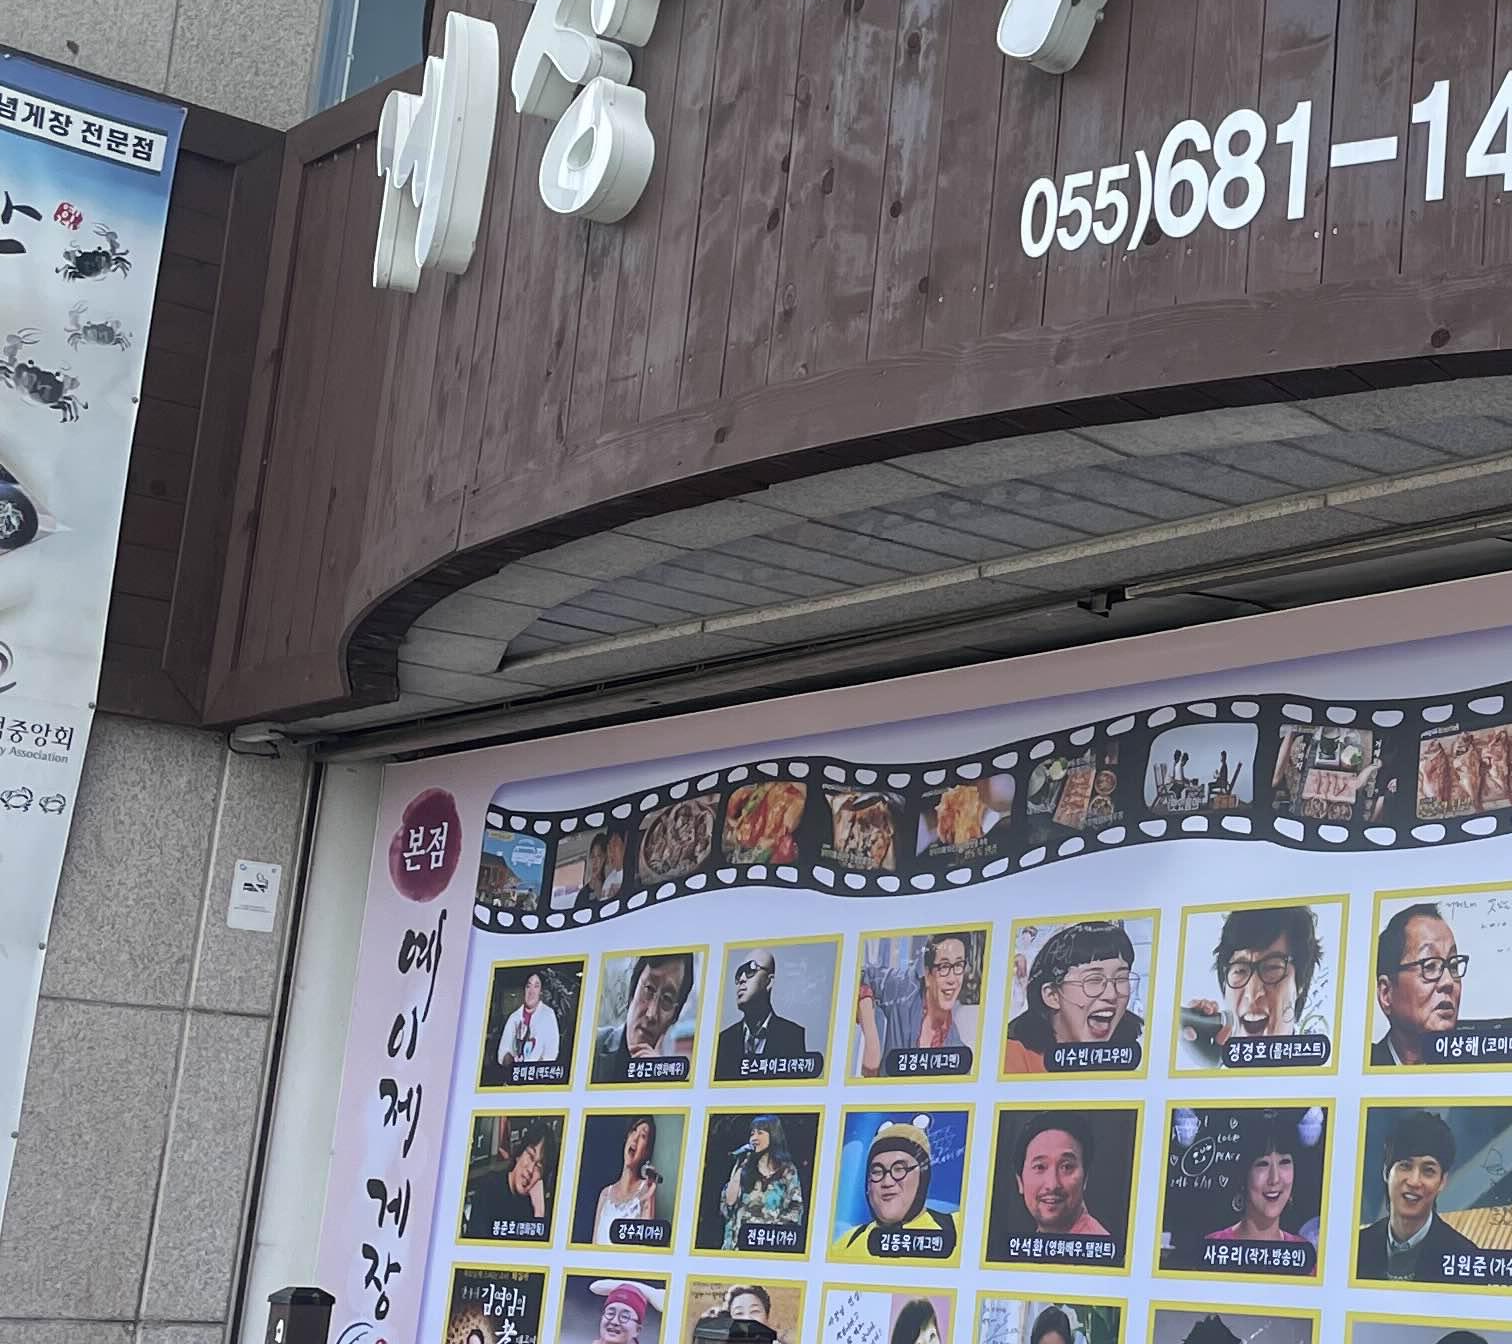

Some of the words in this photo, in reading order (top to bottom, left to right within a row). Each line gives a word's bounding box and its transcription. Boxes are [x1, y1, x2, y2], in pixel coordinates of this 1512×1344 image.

[81, 119, 154, 163] 전문점
[9, 745, 69, 764] Association
[402, 821, 449, 873] 본점
[1228, 1042, 1267, 1062] 정경호
[1434, 1035, 1479, 1057] 이상해
[898, 1054, 928, 1071] 김경식
[1203, 1244, 1242, 1266] 사유리
[1442, 1254, 1487, 1278] 김원준
